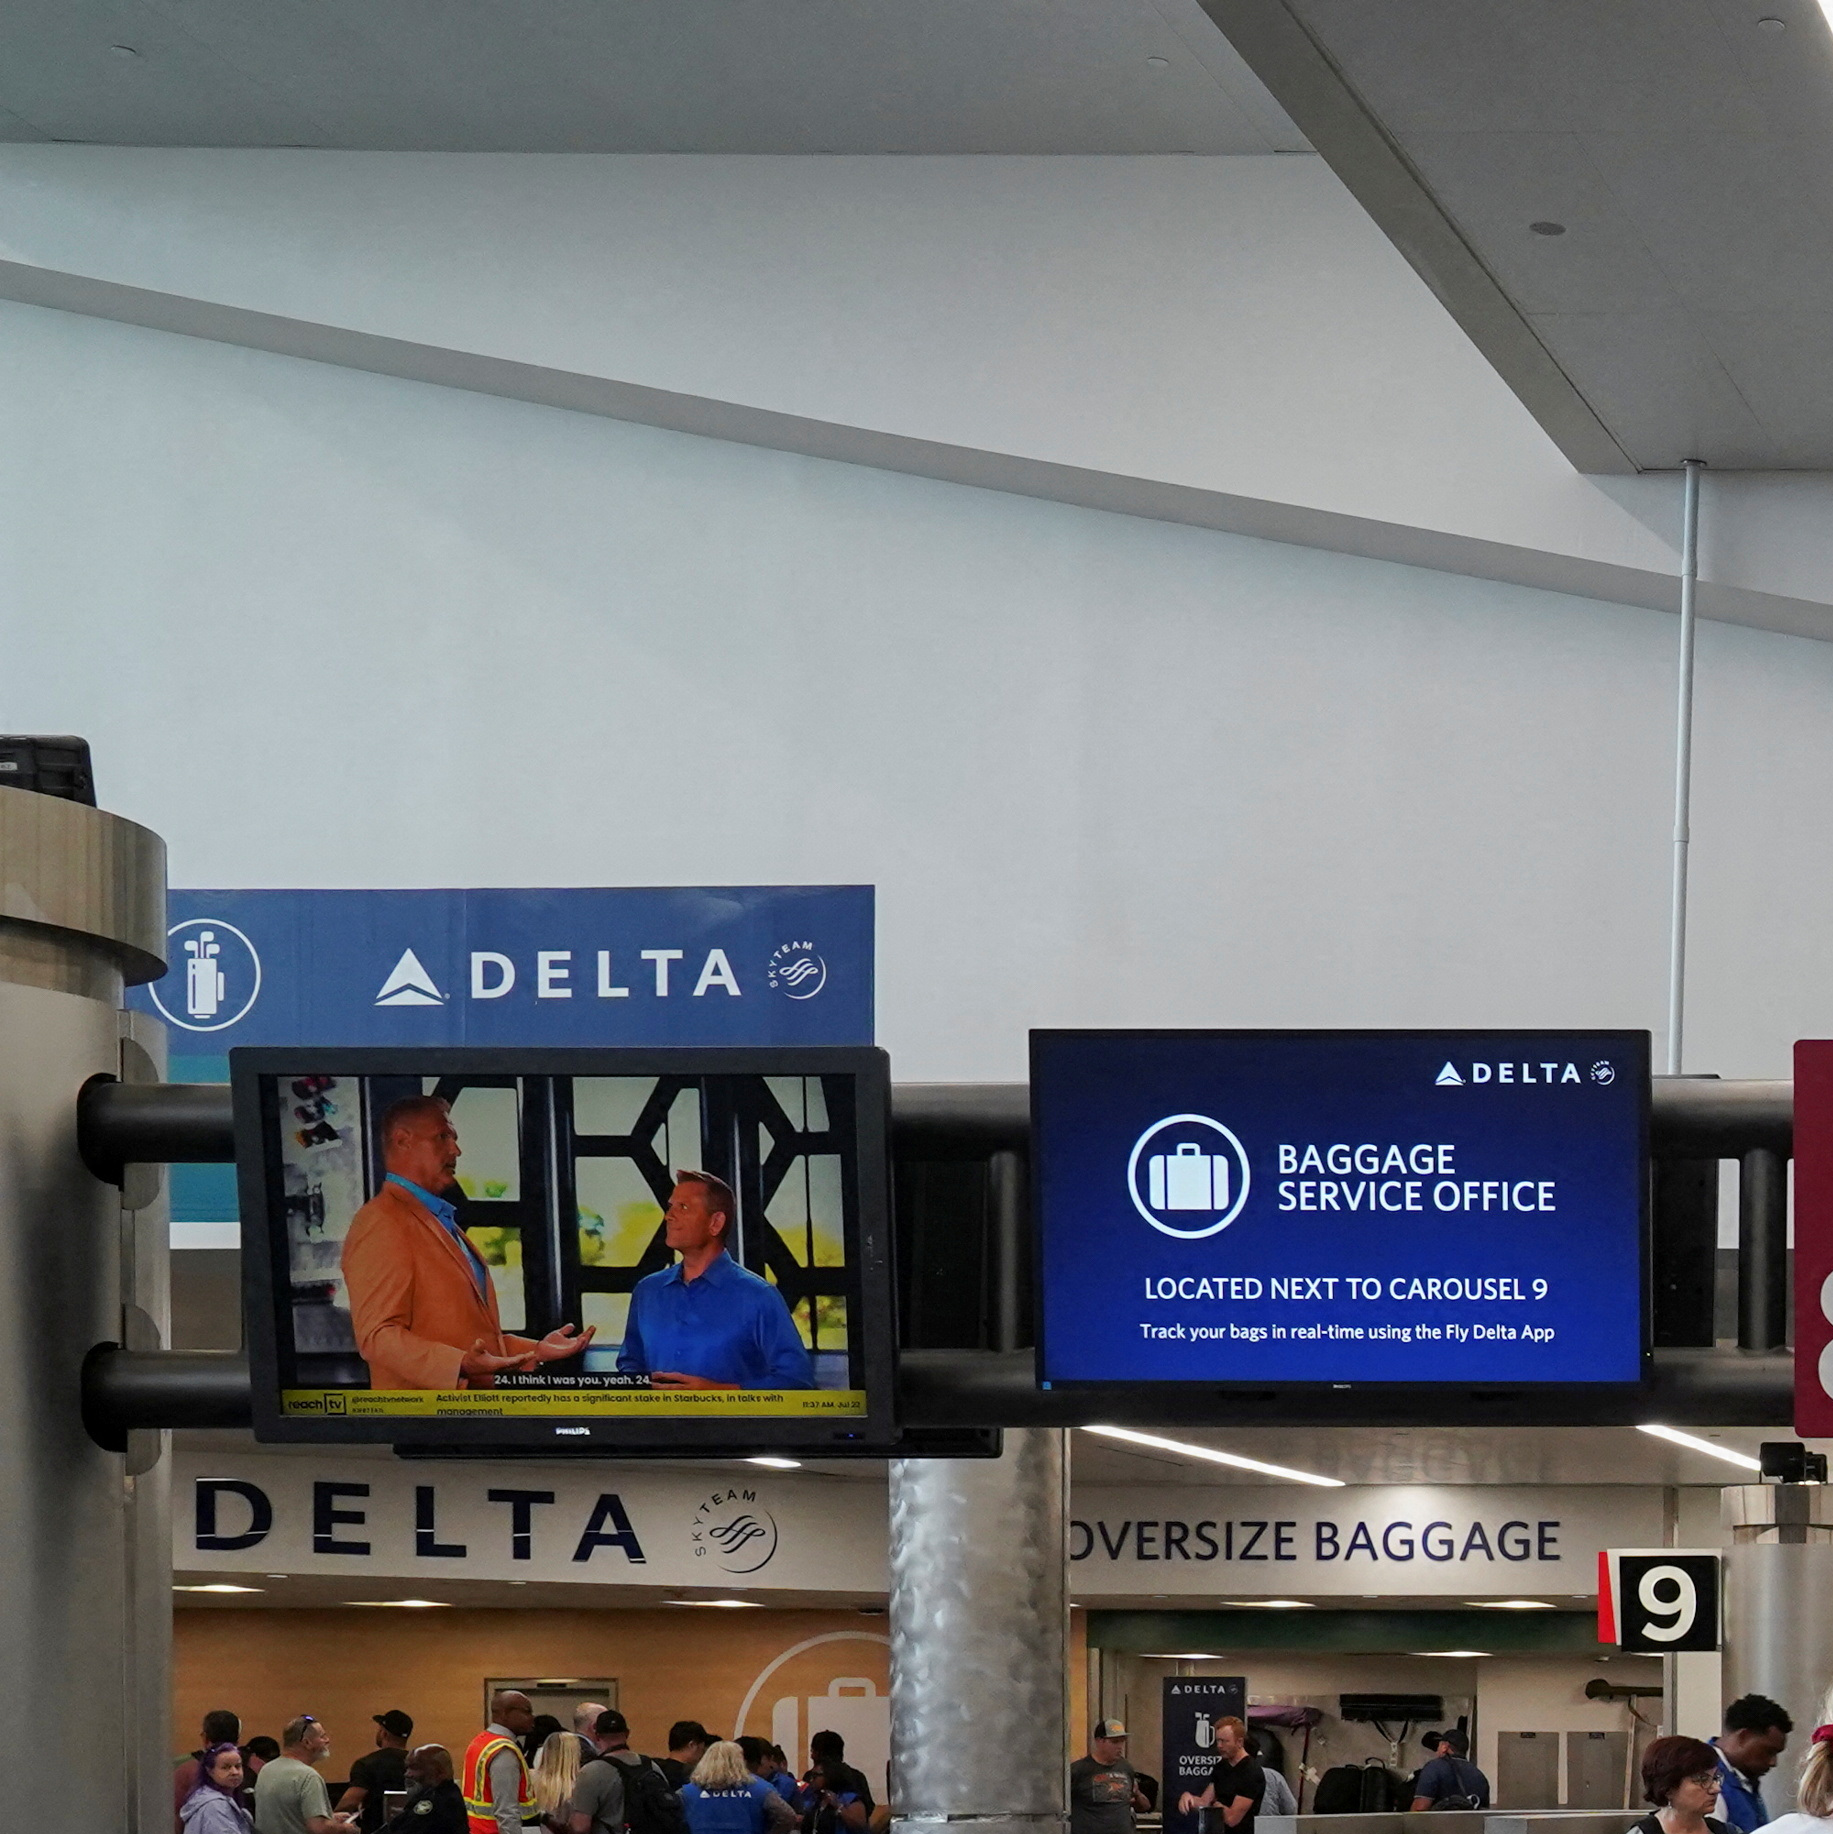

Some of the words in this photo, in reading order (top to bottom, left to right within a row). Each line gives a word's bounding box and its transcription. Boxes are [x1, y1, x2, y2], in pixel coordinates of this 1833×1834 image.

[471, 947, 742, 1000] DELTA
[768, 940, 814, 988] SKYTEAM
[1472, 1062, 1582, 1084] DELTA
[1278, 1143, 1456, 1176] BAGGAGE
[1278, 1180, 1424, 1212] SERVICE
[1433, 1180, 1557, 1212] OFFICE
[1145, 1277, 1263, 1301] LOCATED
[1270, 1277, 1340, 1301] NEXT
[1346, 1277, 1383, 1301] TO
[1388, 1277, 1526, 1301] CAROUSEL
[1531, 1277, 1549, 1301] 9
[1140, 1323, 1186, 1341] Track
[1188, 1326, 1226, 1342] your
[1229, 1323, 1268, 1342] bags
[1272, 1323, 1287, 1340] in
[1290, 1323, 1364, 1340] real-time
[1368, 1324, 1411, 1342] using
[1415, 1324, 1442, 1340] the
[1446, 1324, 1469, 1343] Fly
[1473, 1324, 1517, 1341] Delta
[1521, 1325, 1555, 1343] App
[494, 1374, 512, 1385] 24.
[518, 1375, 547, 1385] think
[552, 1377, 576, 1385] was
[577, 1377, 602, 1386] you.
[603, 1375, 634, 1386] yeah.
[635, 1375, 652, 1385] 24.
[288, 1398, 323, 1411] reach
[327, 1400, 343, 1411] tv
[436, 1394, 471, 1403] Activist
[473, 1394, 500, 1403] Elliott
[501, 1394, 552, 1405] reportedly
[553, 1394, 572, 1403] has
[582, 1393, 632, 1405] significant
[634, 1393, 661, 1403] stake
[673, 1393, 725, 1404] Starbucks,
[737, 1393, 762, 1403] talks
[763, 1393, 784, 1403] with
[802, 1400, 820, 1409] 11:37
[195, 1476, 647, 1565] DELTA
[692, 1488, 757, 1557] SKYTEAM
[1070, 1520, 1298, 1562] OVERSIZE
[1315, 1520, 1561, 1562] BAGGAGE
[1637, 1564, 1698, 1643] 9
[1184, 1685, 1226, 1694] DELTA
